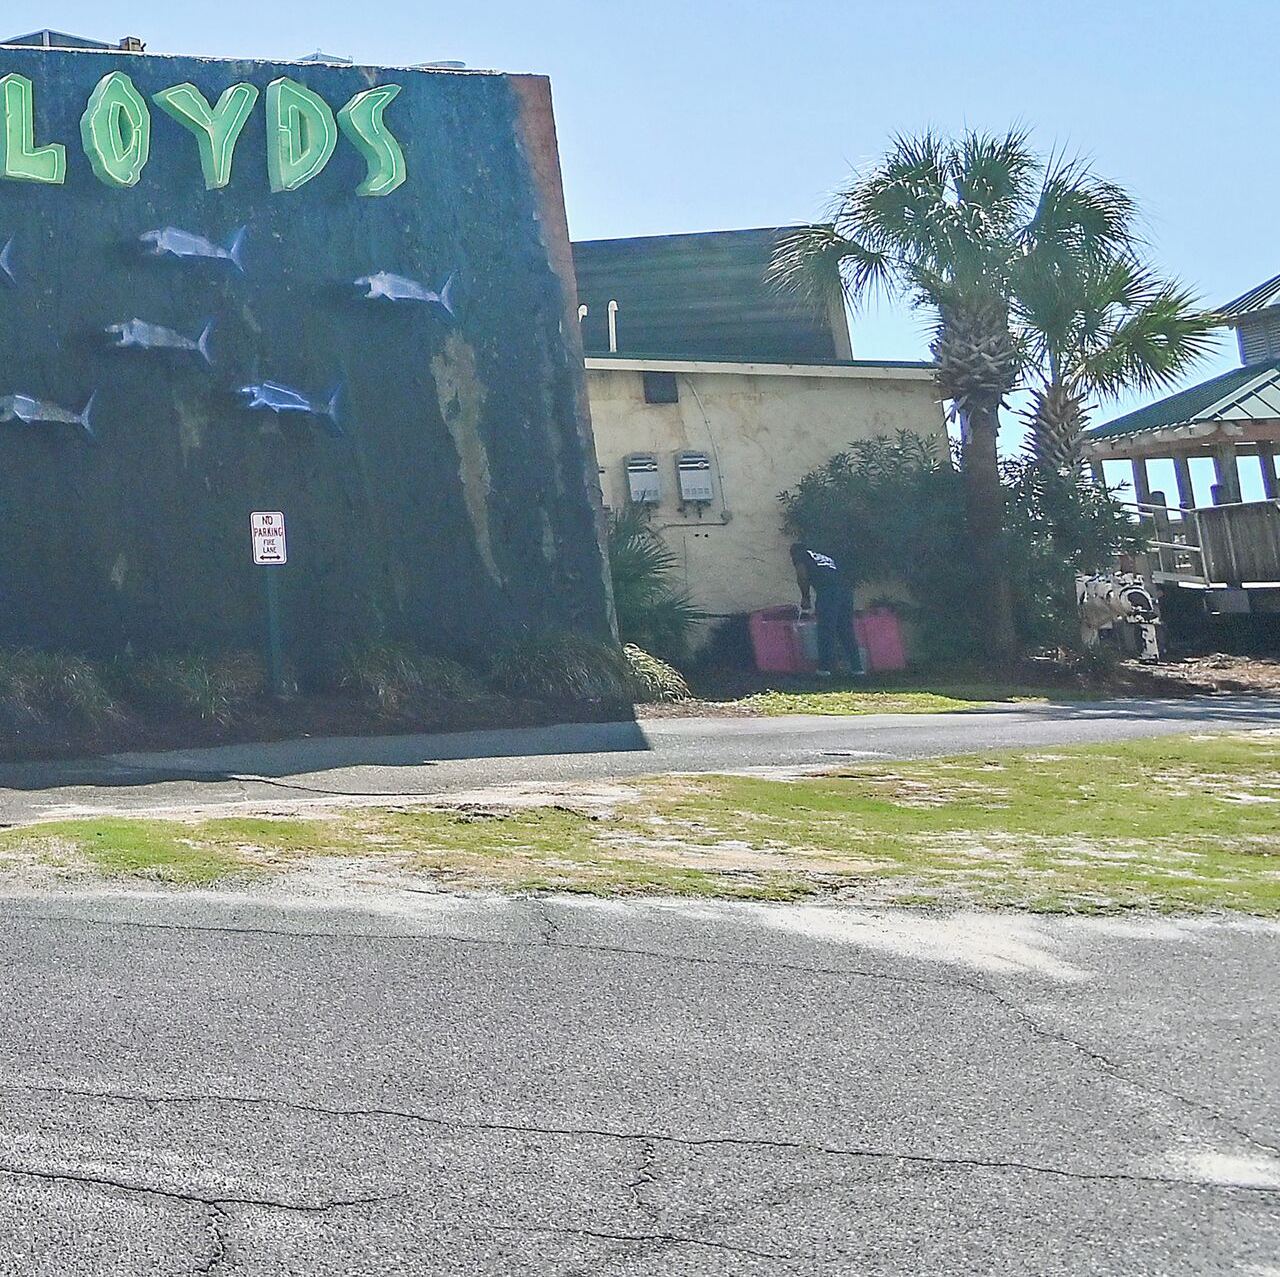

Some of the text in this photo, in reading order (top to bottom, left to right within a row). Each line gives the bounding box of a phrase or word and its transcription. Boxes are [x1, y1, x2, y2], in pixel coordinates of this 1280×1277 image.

[262, 516, 273, 526] NO
[254, 527, 283, 537] PARKING
[263, 538, 275, 546] FIRE
[262, 546, 277, 554] LANE
